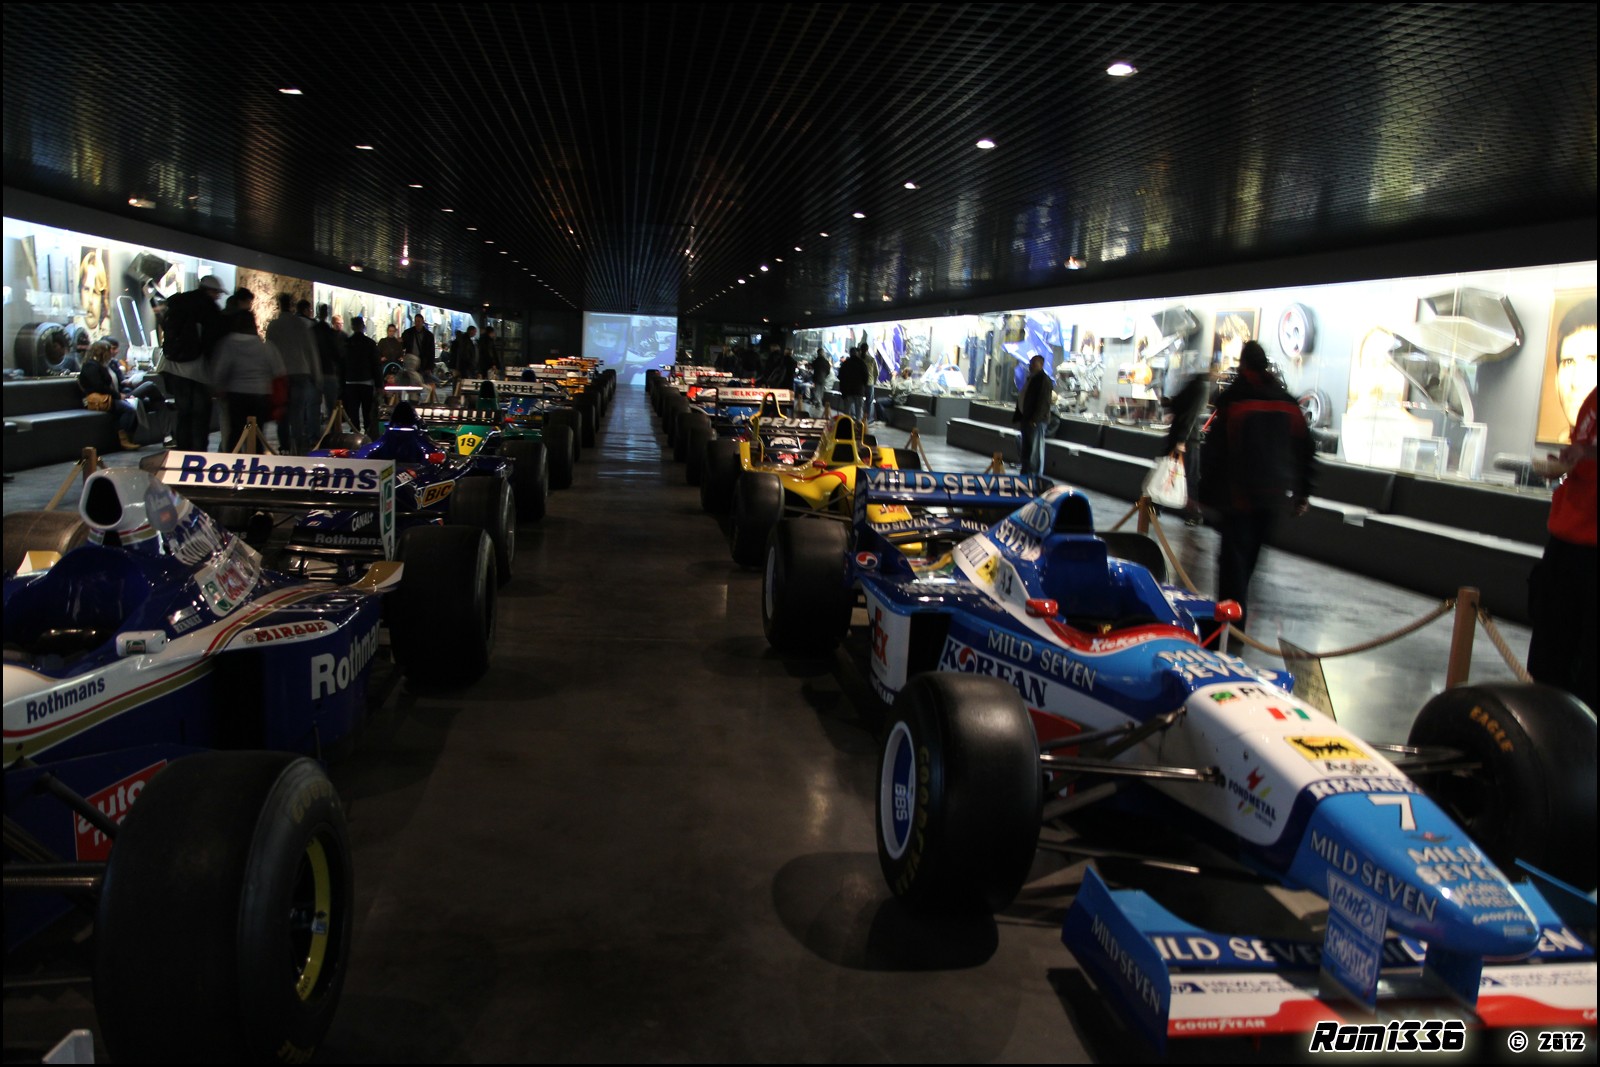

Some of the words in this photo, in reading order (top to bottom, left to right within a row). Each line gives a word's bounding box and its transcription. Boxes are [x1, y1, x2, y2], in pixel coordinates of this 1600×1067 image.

[759, 417, 827, 428] PEUGE
[461, 438, 476, 447] 19
[179, 455, 378, 490] Rothmans
[866, 471, 937, 493] MILD
[943, 474, 1034, 498] SEVEN
[315, 533, 383, 547] Rothmans
[255, 621, 328, 643] MIRAGE
[987, 628, 1034, 663] MILD
[1039, 649, 1098, 692] SEVEN
[26, 676, 106, 724] Rothmans
[894, 782, 909, 822] BBS
[1228, 779, 1277, 822] FONDMETAL
[1367, 793, 1417, 831] 7
[1311, 829, 1358, 877] MILD
[1360, 862, 1438, 922] SEVEN
[1091, 913, 1120, 960] MILD
[1118, 950, 1161, 1016] SEVEN
[1152, 934, 1220, 961] ILD
[1174, 1019, 1267, 1032] GOODYEAR
